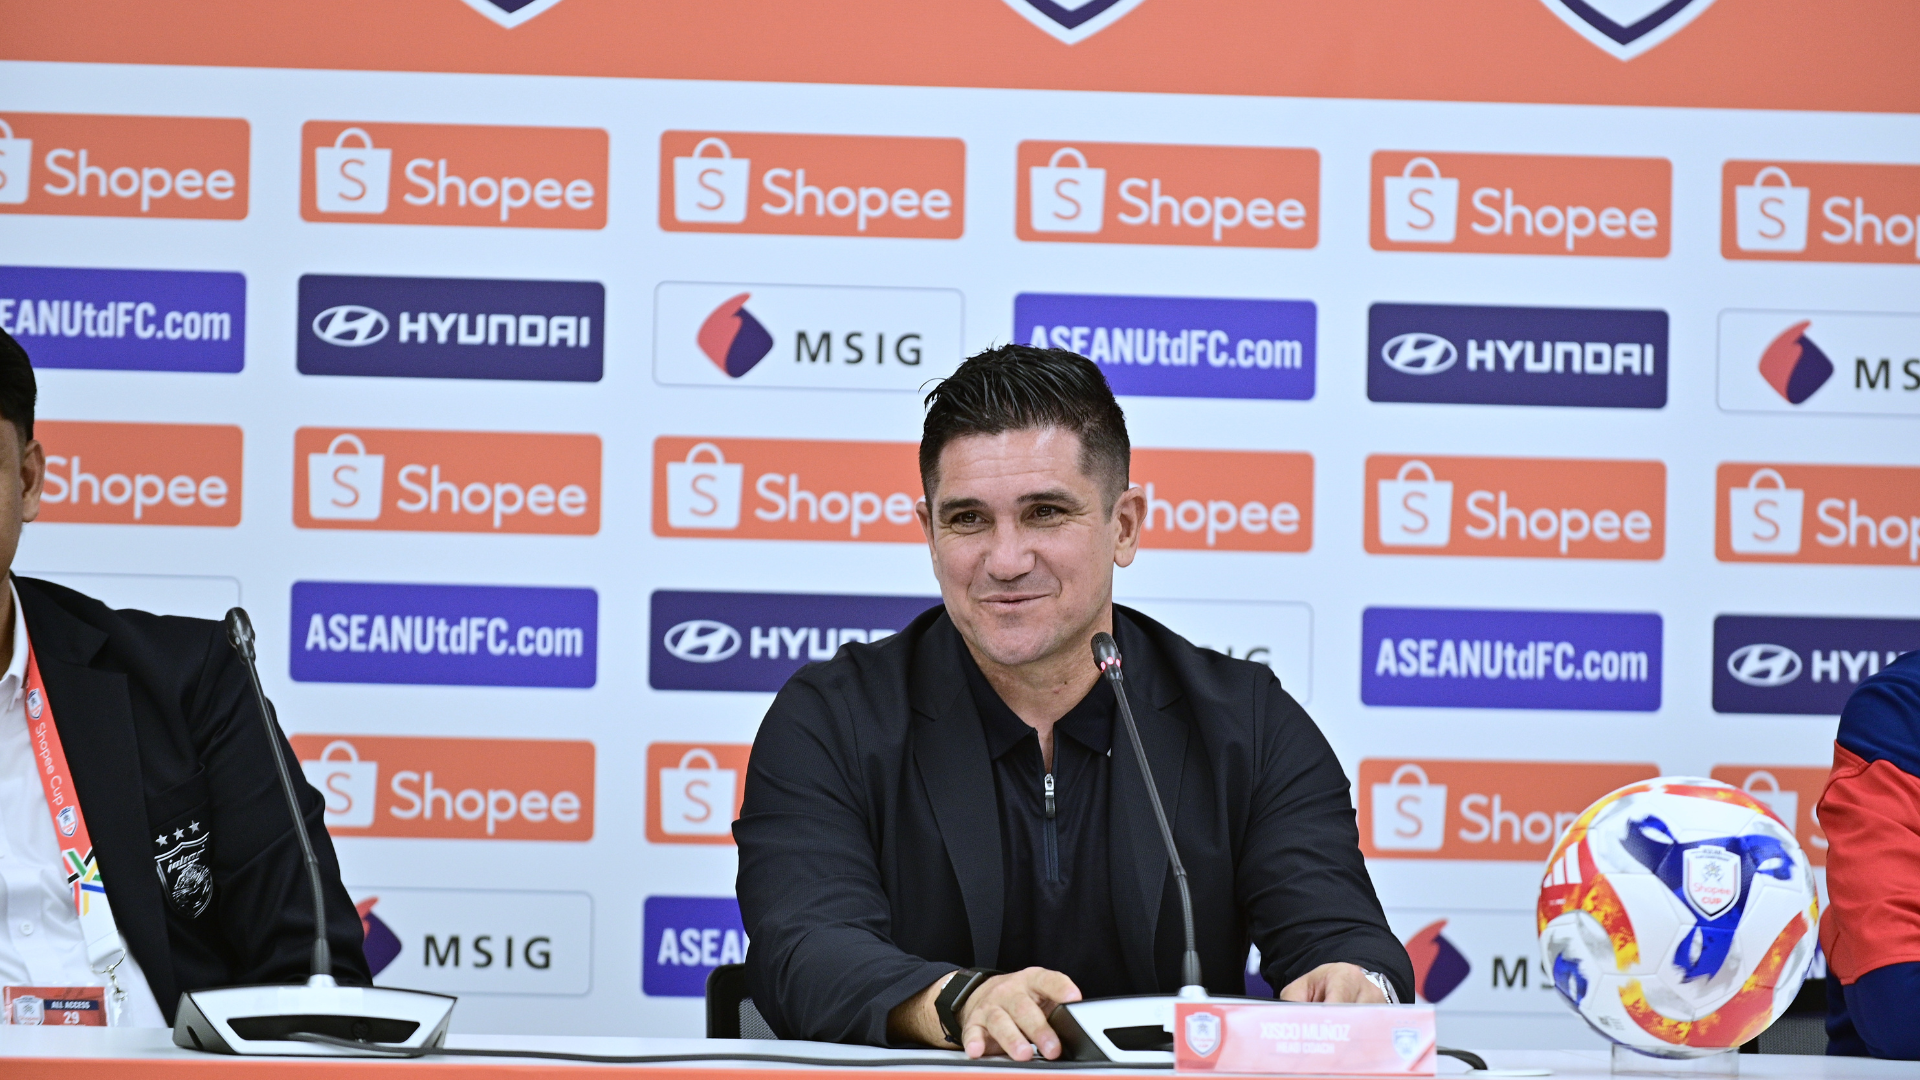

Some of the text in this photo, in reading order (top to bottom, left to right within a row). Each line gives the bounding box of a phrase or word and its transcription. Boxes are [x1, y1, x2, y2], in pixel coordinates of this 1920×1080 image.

[44, 148, 235, 212] Shopee
[404, 158, 594, 222] Shopee
[762, 168, 952, 231] Shopee
[1118, 178, 1306, 241] Shopee
[1471, 187, 1658, 251] Shopee
[1822, 196, 1920, 259] Sho
[400, 313, 589, 346] HYUNDAI
[796, 331, 921, 366] MSIG
[1030, 326, 1301, 368] ASEANUtdFC.com
[1468, 340, 1653, 373] HYUNDAI
[42, 455, 228, 519] Shopee
[397, 464, 587, 528] Shopee
[755, 473, 925, 537] Shope
[1130, 482, 1300, 545] hopee
[1465, 490, 1651, 554] Shopee
[306, 615, 582, 655] ASEANUtdFC.com
[1377, 640, 1647, 679] ASEANUtdFC.com
[35, 722, 65, 806] Shopee Cup
[391, 771, 581, 835] Shopee
[1694, 883, 1731, 895] Shopee
[424, 935, 550, 969] MSIG
[659, 930, 750, 964] ASEA
[51, 1001, 91, 1010] ALL ACCESS
[63, 1011, 80, 1024] 29
[1259, 1019, 1351, 1041] XISCO MUÑOZ
[1276, 1041, 1335, 1054] HEAD COACH
